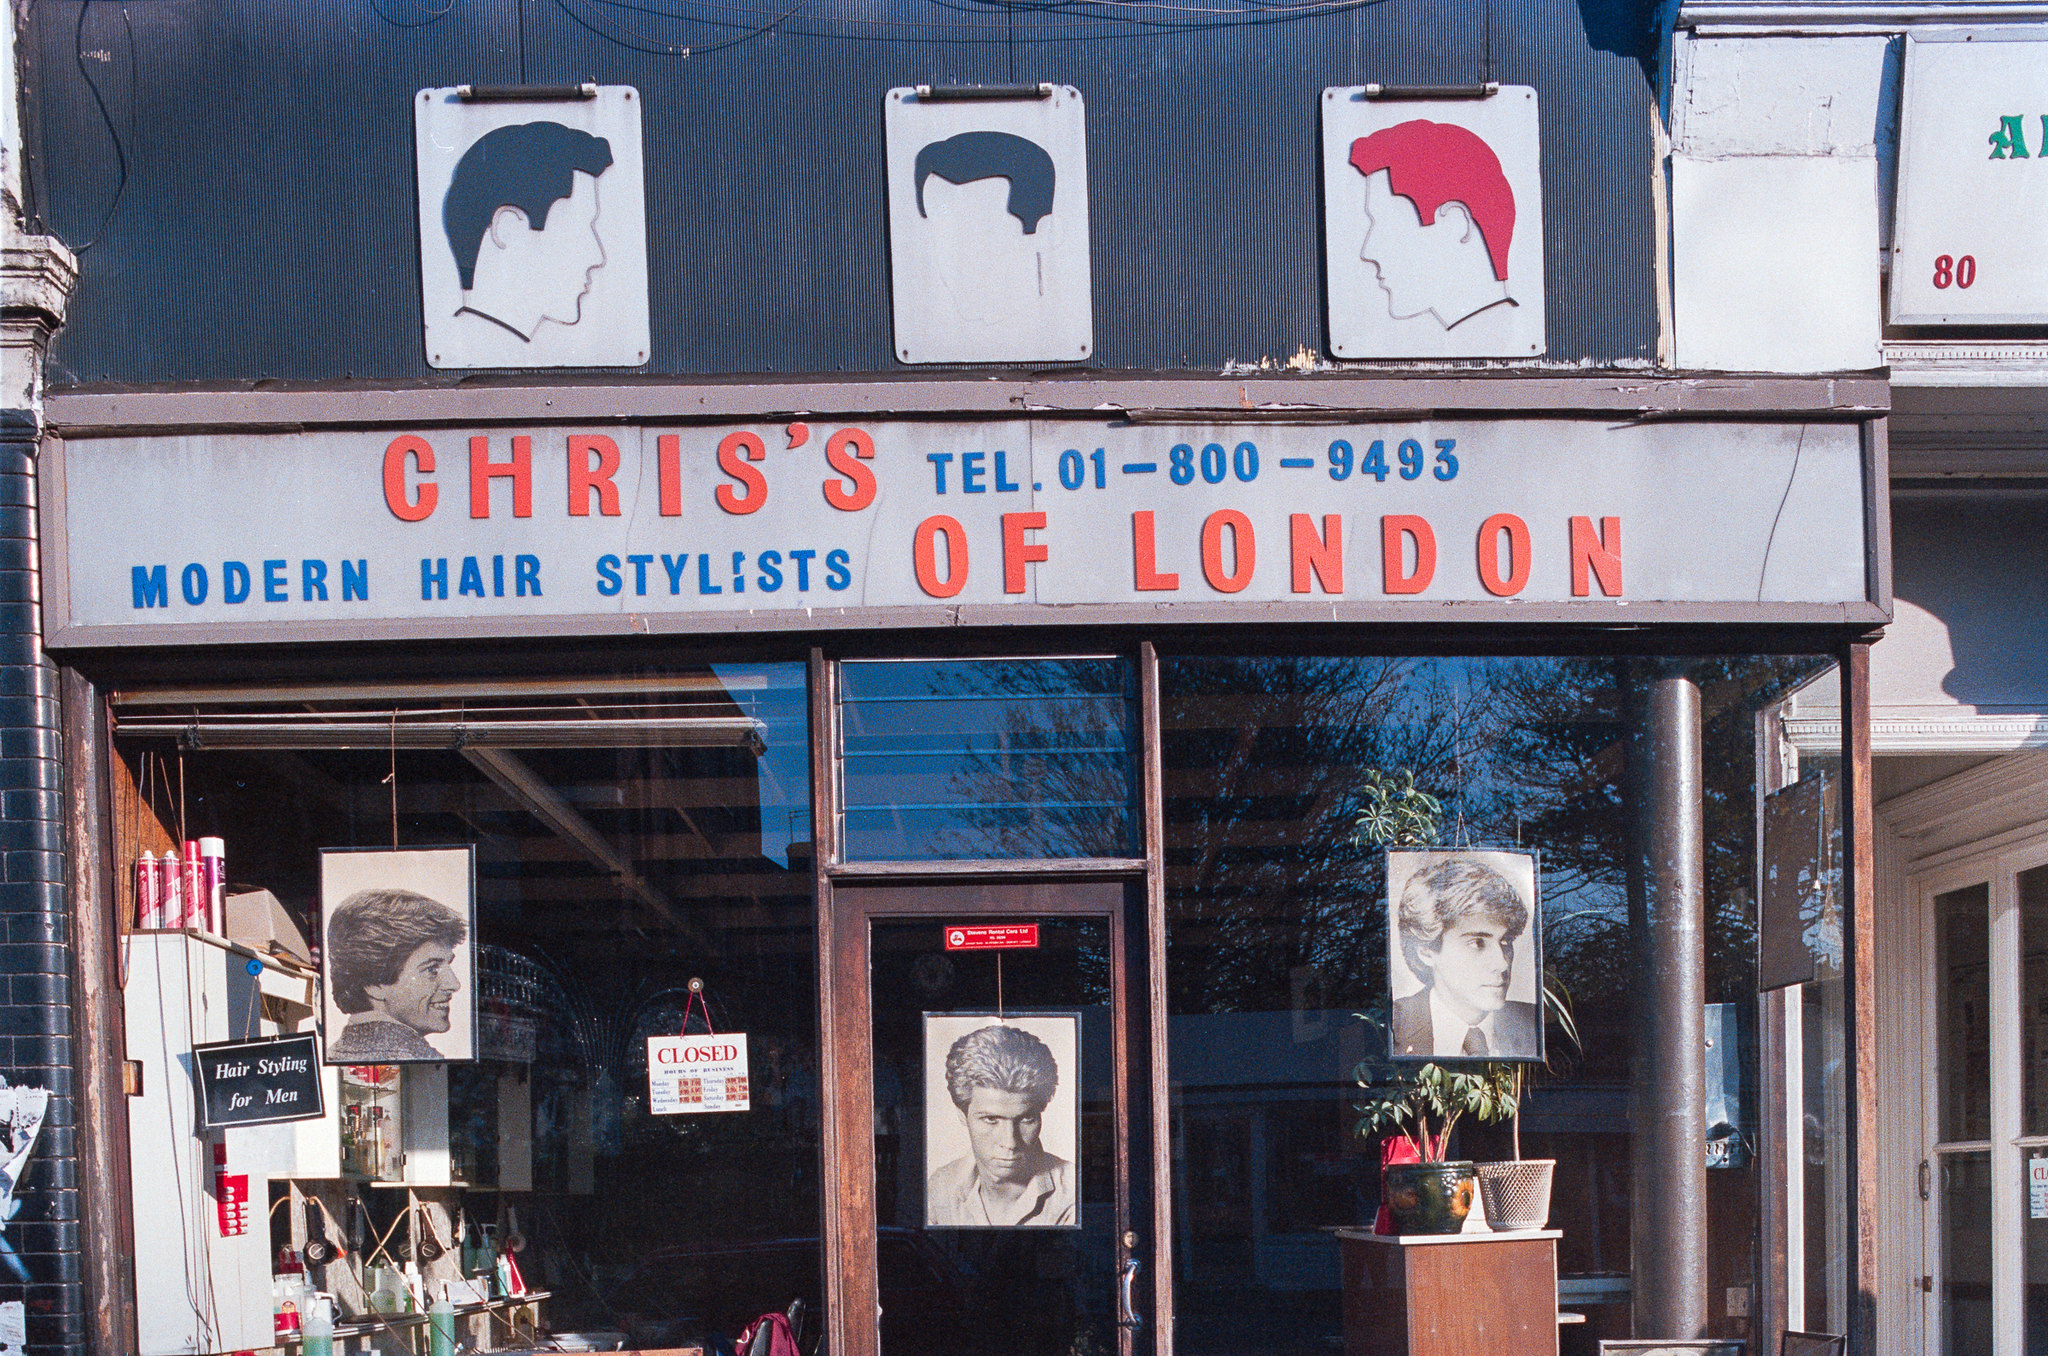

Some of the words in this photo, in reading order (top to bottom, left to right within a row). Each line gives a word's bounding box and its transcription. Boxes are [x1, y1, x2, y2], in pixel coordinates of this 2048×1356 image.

[1933, 254, 1977, 289] 80
[383, 423, 878, 523] CHRIS'S
[914, 511, 1049, 599] OF
[1133, 508, 1624, 597] LONDON
[131, 558, 370, 610] MODERN
[420, 553, 544, 601] HAIR
[596, 548, 853, 597] STYLISTS
[215, 1061, 251, 1079] Hair
[257, 1056, 308, 1077] Styling
[657, 1045, 738, 1064] CLOSED
[228, 1092, 253, 1111] for
[265, 1088, 298, 1105] Men
[2034, 1167, 2048, 1180] CL
